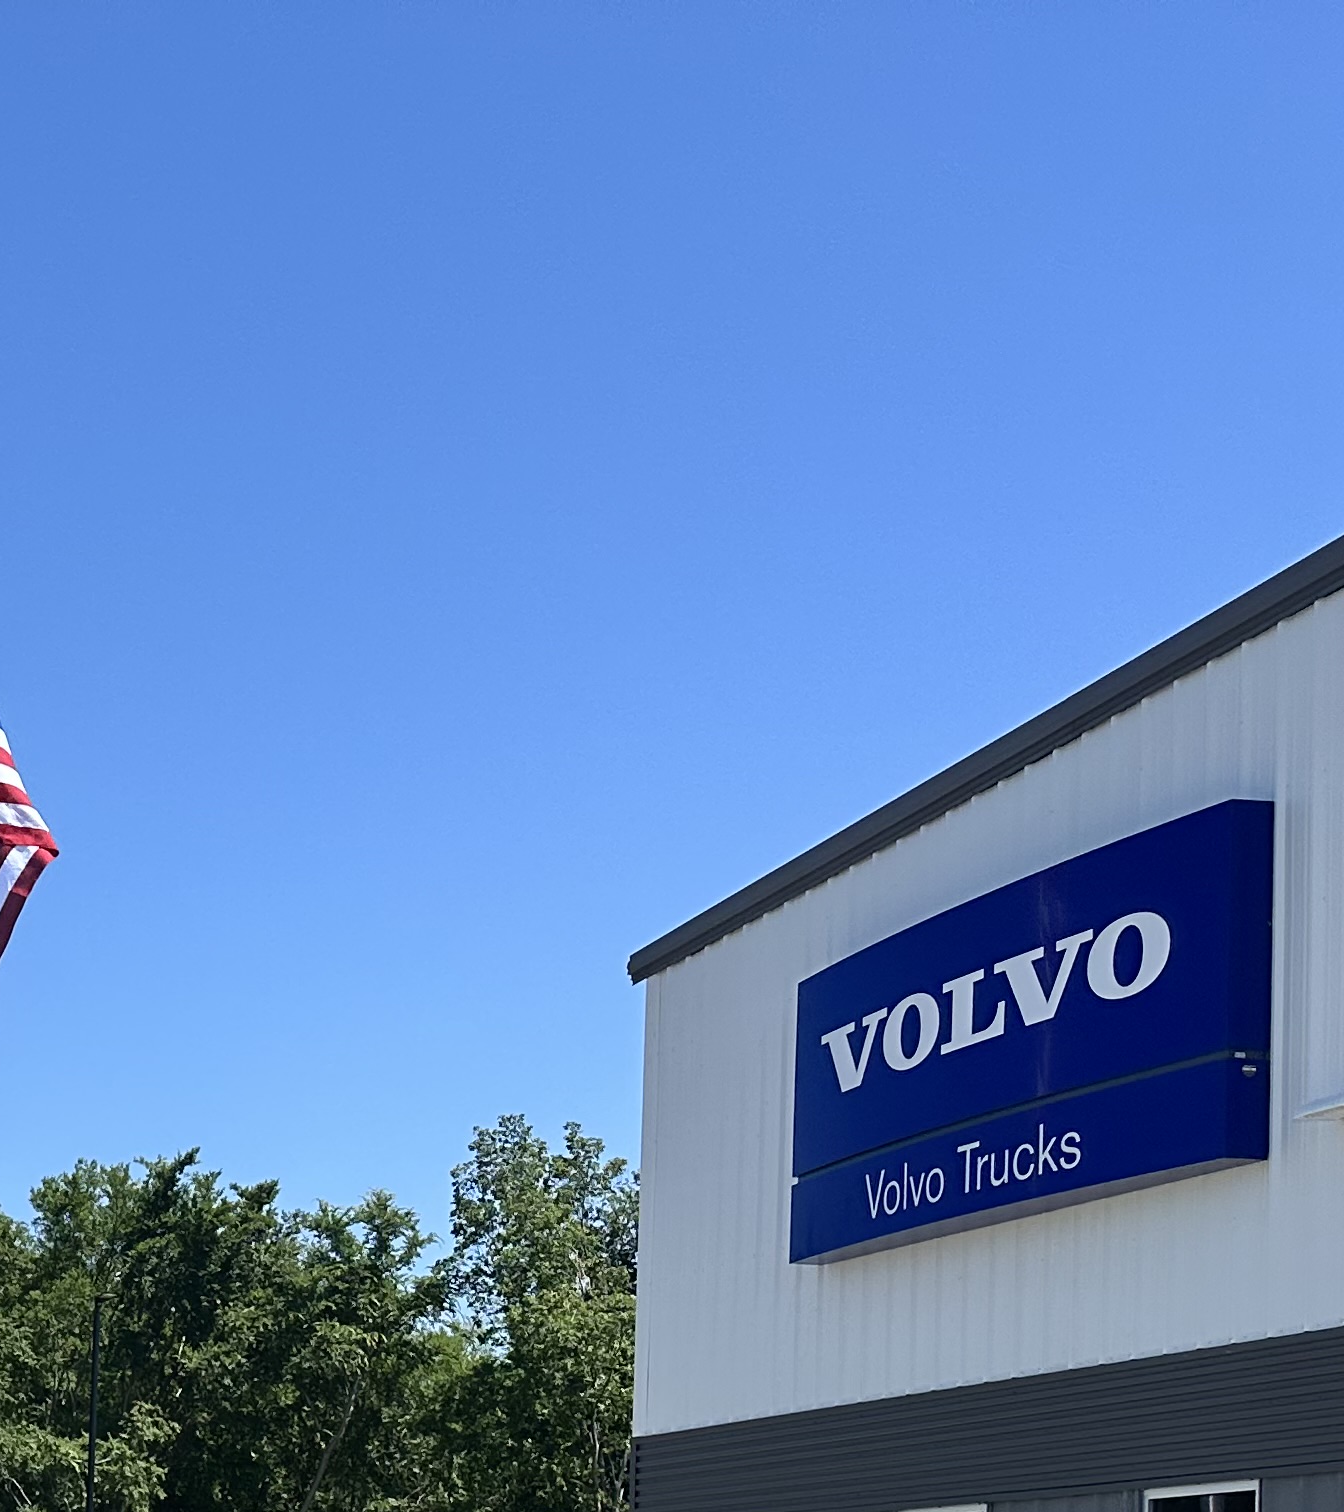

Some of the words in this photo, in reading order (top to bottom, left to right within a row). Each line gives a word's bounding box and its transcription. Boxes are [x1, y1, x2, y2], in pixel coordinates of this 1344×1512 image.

[821, 912, 1170, 1092] VOLVO
[866, 1163, 944, 1218] Volvo
[957, 1124, 1080, 1193] Trucks
